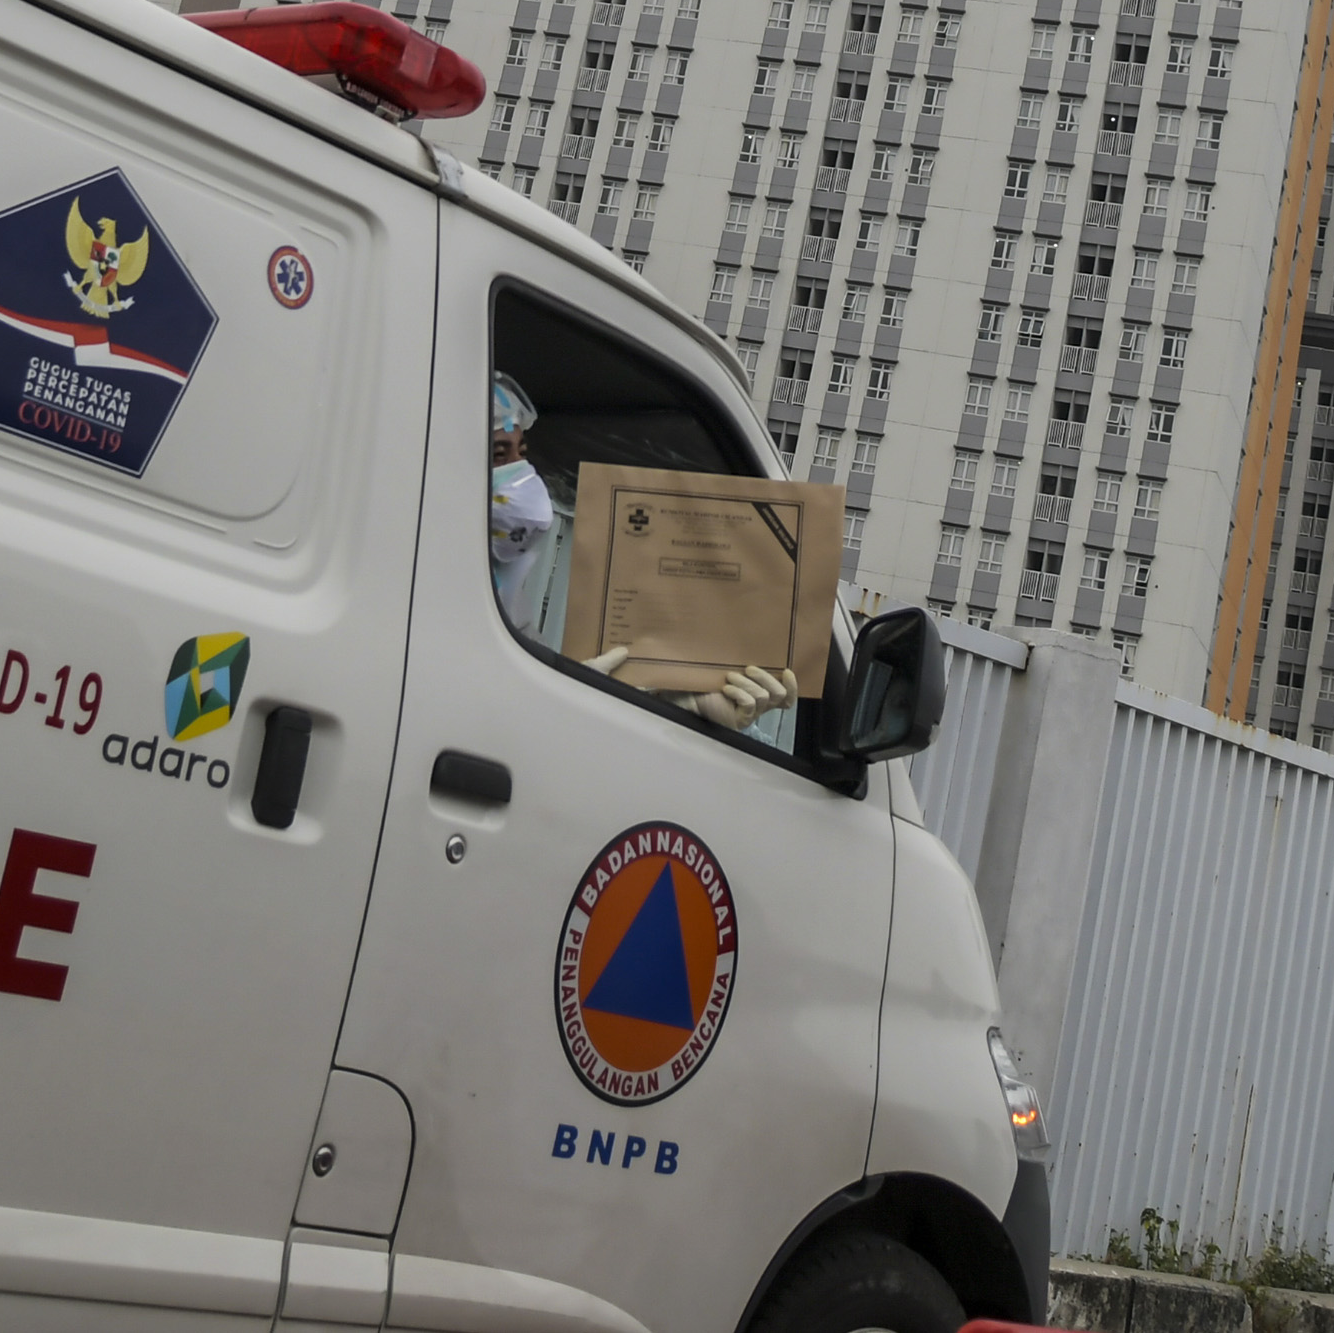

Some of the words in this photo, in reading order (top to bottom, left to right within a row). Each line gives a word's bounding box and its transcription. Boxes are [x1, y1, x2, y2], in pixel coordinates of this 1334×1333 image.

[23, 381, 127, 428] PENANGANAN
[26, 368, 130, 415] PERCEPATAN
[30, 356, 80, 384] GUGUS
[85, 376, 132, 404] TUGAS
[17, 399, 122, 453] COVID-19
[102, 733, 230, 789] adaro
[581, 832, 652, 909] BADAN
[656, 830, 733, 945] NASIONAL
[560, 928, 660, 1097] PENANGGULANGAN
[670, 971, 731, 1082] BENCANA
[551, 1122, 680, 1176] BNPB
